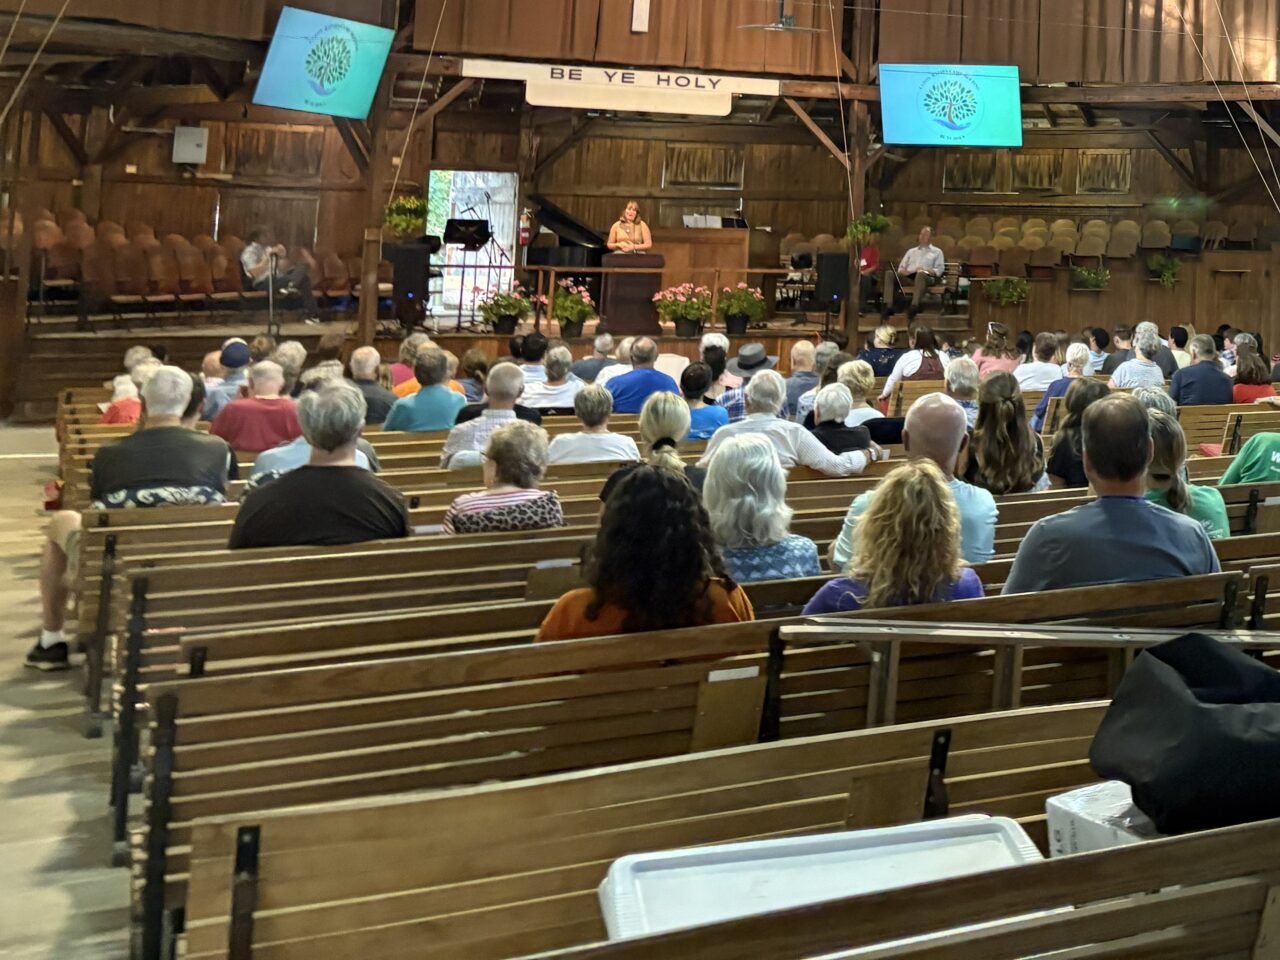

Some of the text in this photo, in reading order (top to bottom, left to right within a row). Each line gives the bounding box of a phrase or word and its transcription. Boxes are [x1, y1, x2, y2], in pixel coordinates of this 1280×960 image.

[550, 67, 721, 90] BE YE HOLY
